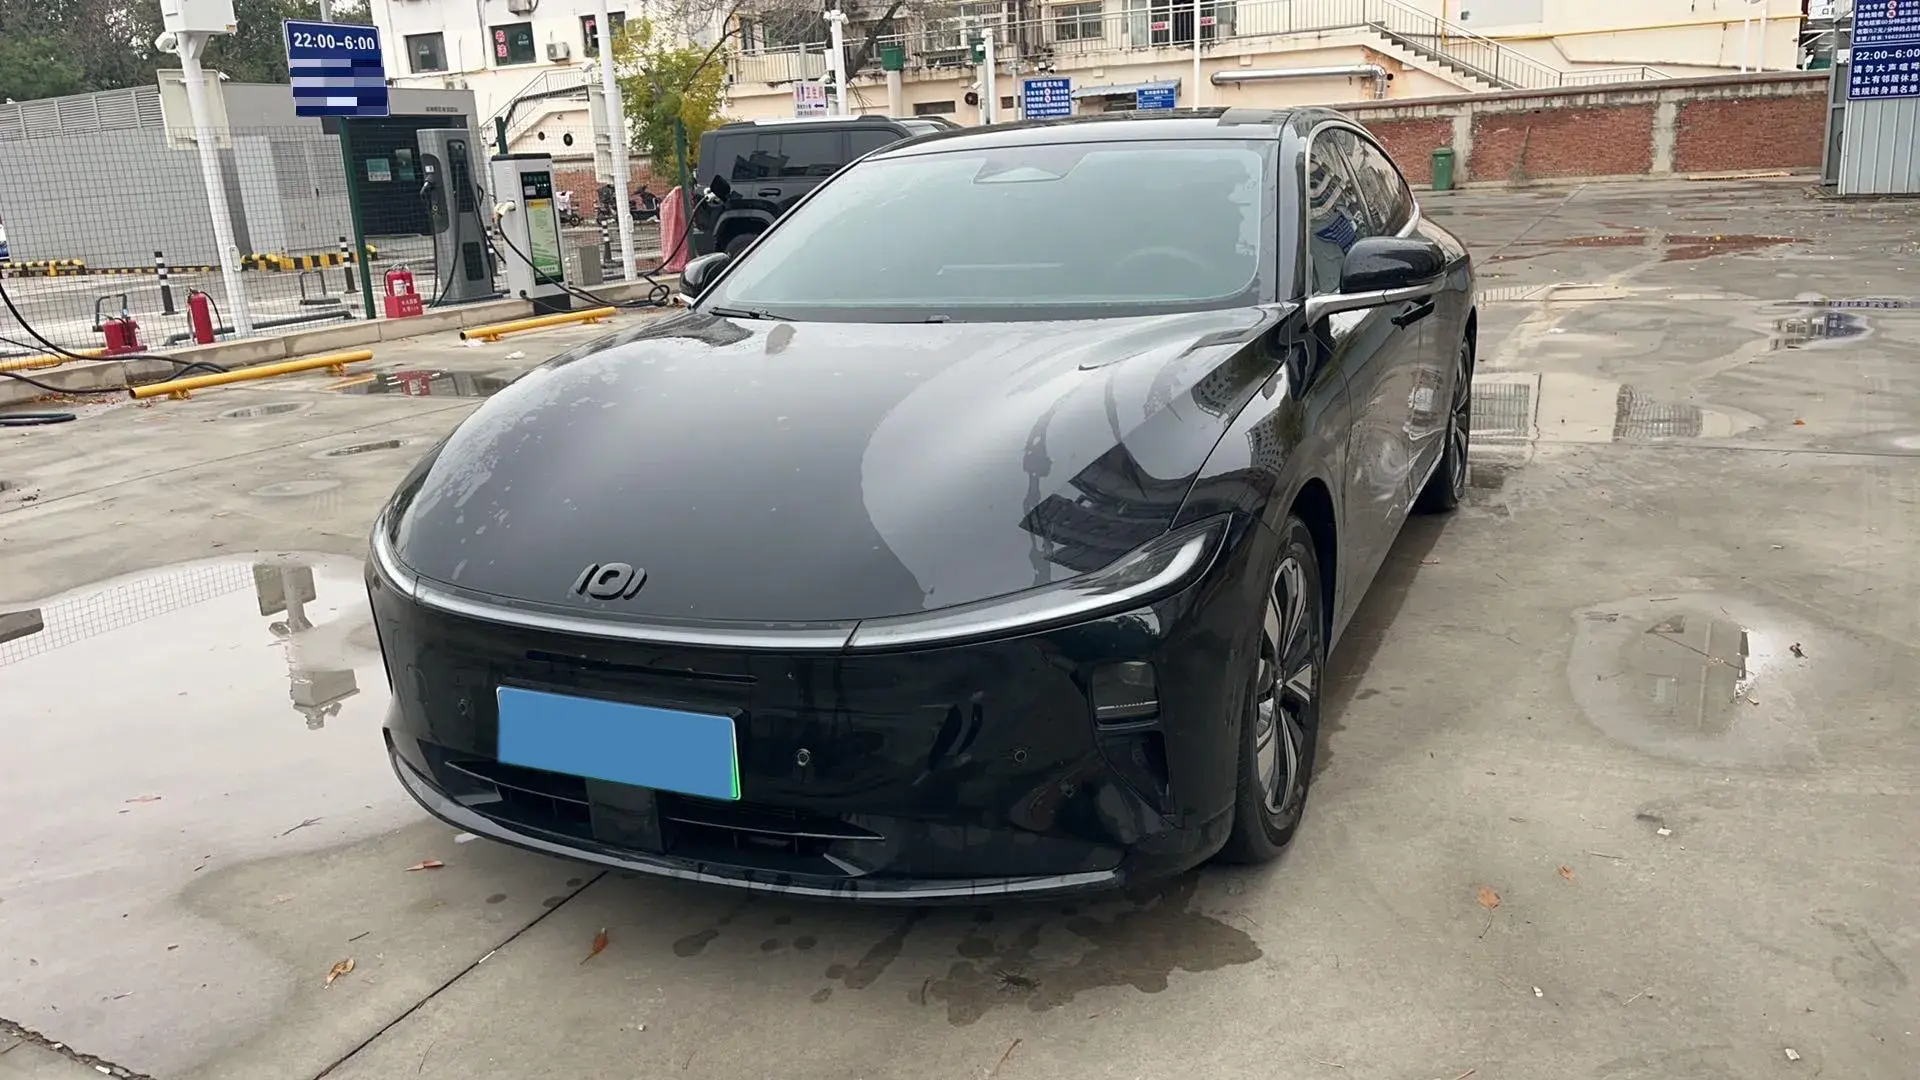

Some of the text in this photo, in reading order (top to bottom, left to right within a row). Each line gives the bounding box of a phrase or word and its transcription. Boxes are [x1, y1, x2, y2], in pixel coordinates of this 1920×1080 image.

[293, 32, 375, 50] 22:00-6:00
[1856, 49, 1920, 60] 22:00-6:00
[1853, 62, 1920, 73] 请勿大声喧哗
[1852, 73, 1919, 85] 楼上有邻居休息
[1852, 85, 1918, 95] 违规终身黑名单
